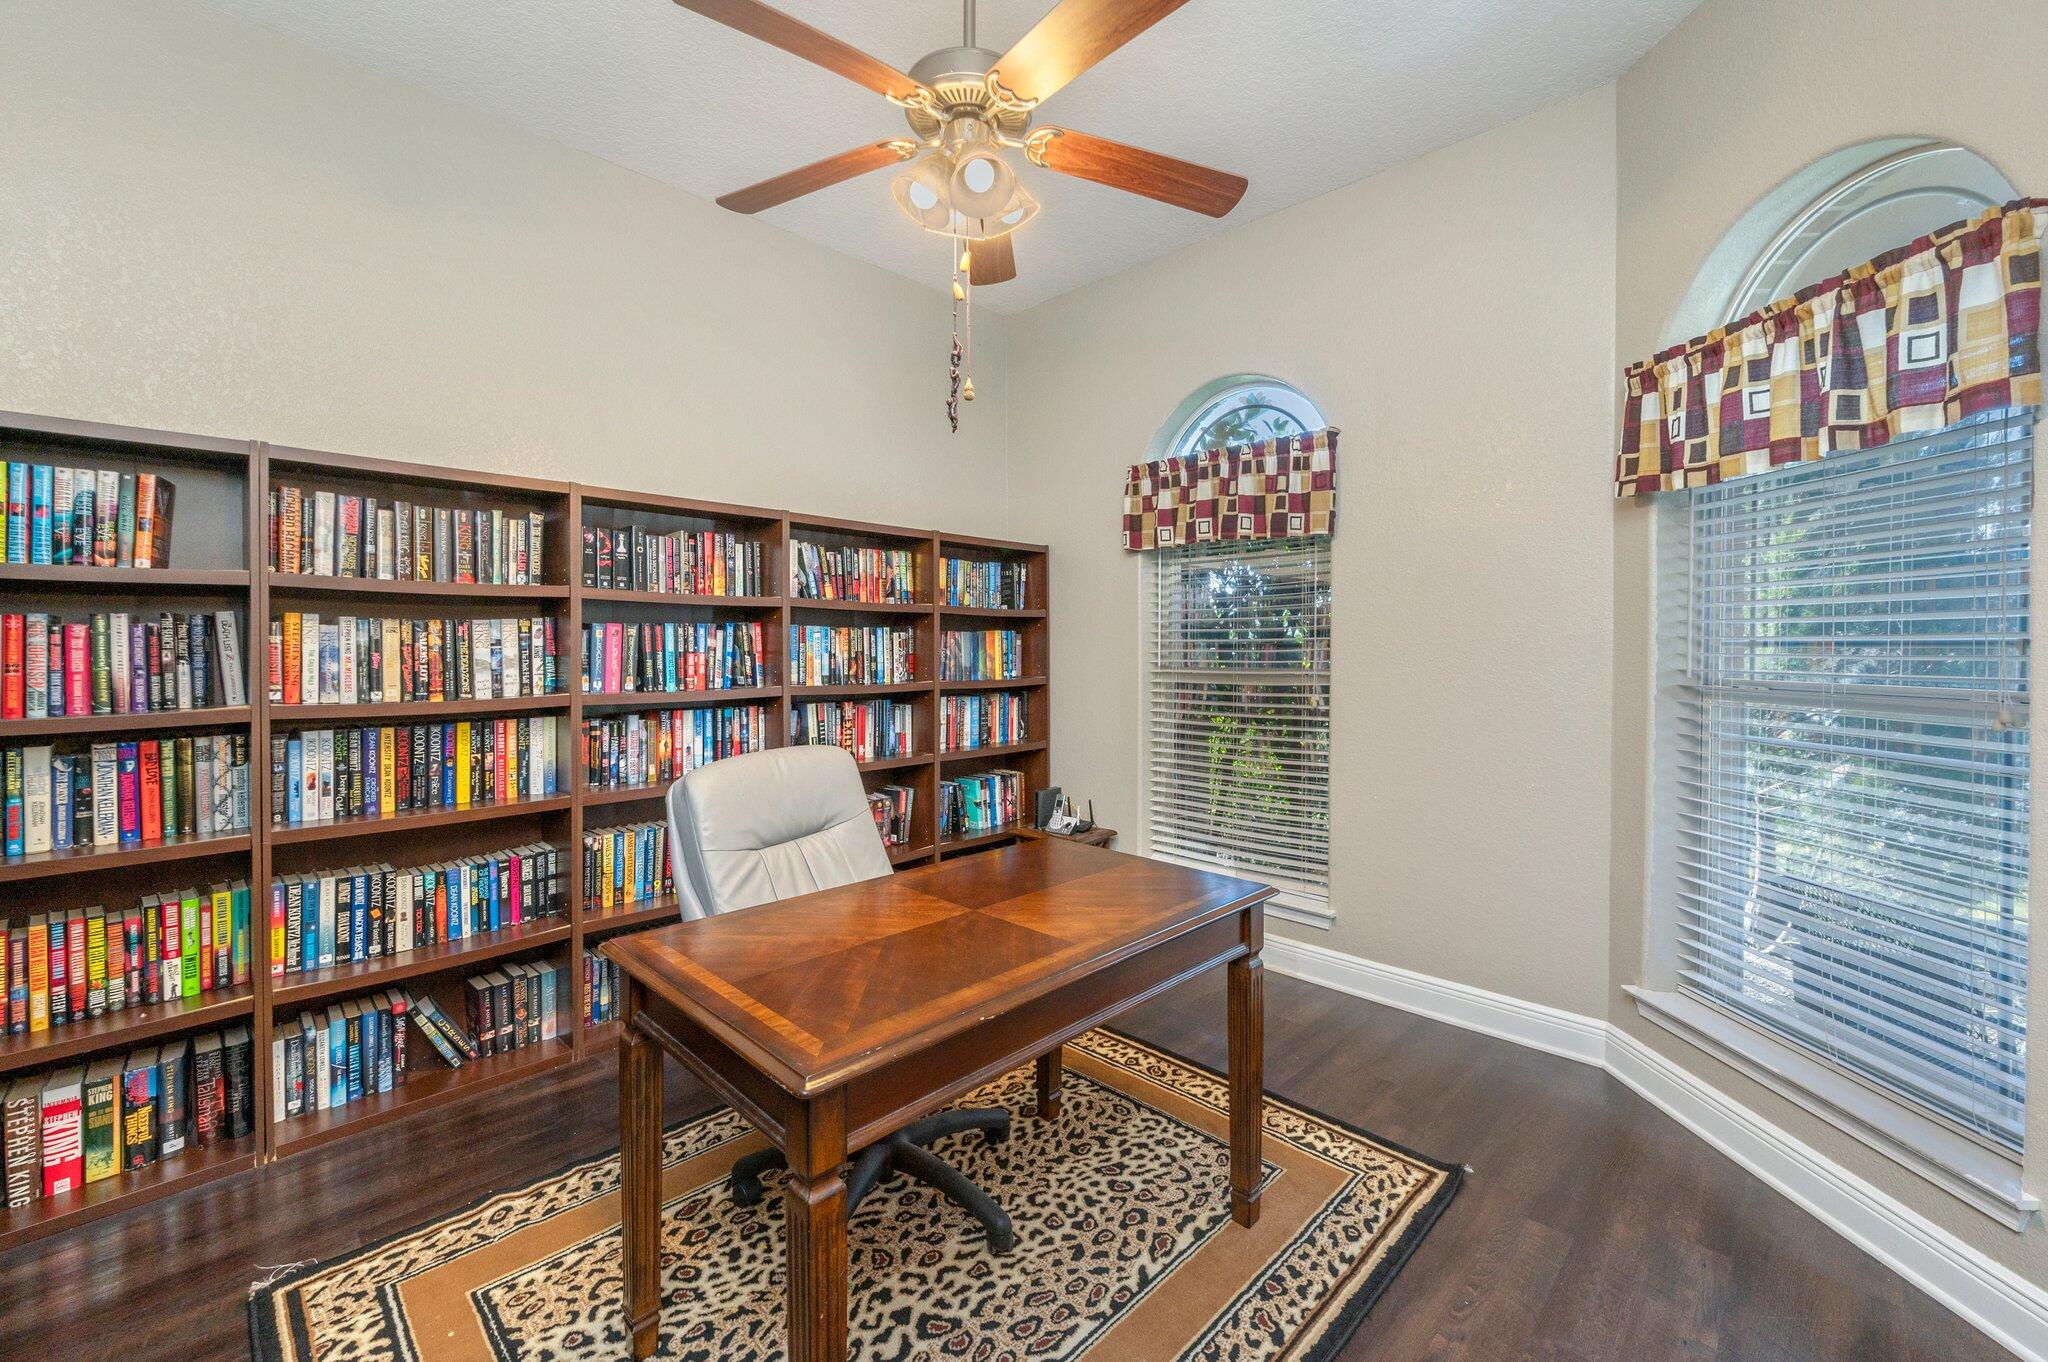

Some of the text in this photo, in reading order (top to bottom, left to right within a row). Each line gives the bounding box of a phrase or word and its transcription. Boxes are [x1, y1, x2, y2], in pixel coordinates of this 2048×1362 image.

[419, 523, 427, 539] KING
[459, 524, 469, 551] KING
[473, 623, 484, 649] KING
[28, 641, 46, 688] JOHANSEN
[291, 621, 300, 686] STEPHEN KING
[460, 640, 469, 693] THE DEAD ZONE
[419, 664, 428, 682] LOT
[306, 740, 316, 772] KOONTZ
[321, 739, 332, 771] KOONTZ
[349, 749, 358, 771] KOONTZ
[384, 733, 392, 760] INTENSITY
[414, 731, 425, 764] KOONTZ
[430, 728, 441, 761] KOONTZ
[145, 767, 158, 786] LOVE
[384, 779, 392, 798] KOONTZ
[97, 764, 114, 836] JONATHAN KELLERMAN
[425, 876, 435, 906] KOONTZ
[605, 857, 613, 894] PATTERSON
[371, 879, 381, 907] KOONTZ
[385, 875, 396, 909] KOONTZ
[437, 884, 447, 911] KOONTZ
[450, 886, 458, 926] DEAN KOONTZ
[217, 896, 228, 944] JONATHAN KELLERMAN
[288, 885, 301, 939] DEAN KOONTZ
[355, 909, 364, 932] DRAGON
[147, 908, 157, 961] JONATHAN KELLERMAN
[165, 905, 179, 951] JONATHAN KELLERMAN
[70, 924, 84, 984] JONATHAN KELLERMAN
[184, 952, 197, 980] TWISTED
[52, 985, 65, 1013] MYSTERY
[89, 990, 105, 1009] GUILT
[109, 977, 124, 1003] MOTIVE
[395, 1016, 406, 1031] SIGN
[437, 1019, 470, 1052] CURSES
[166, 1065, 174, 1095] STEPHEN
[214, 1051, 222, 1079] STEPHEN
[88, 1083, 113, 1096] STEPHEN
[88, 1090, 113, 1106] KING
[197, 1078, 216, 1132] Talisman
[26, 1098, 37, 1164] DESPERATION
[44, 1110, 81, 1125] STEPHEN
[89, 1112, 113, 1129] STAND
[125, 1112, 139, 1146] THINGS
[137, 1105, 152, 1144] NEEDFUL
[6, 1098, 31, 1208] STEPHEN KING
[42, 1118, 80, 1167] KING
